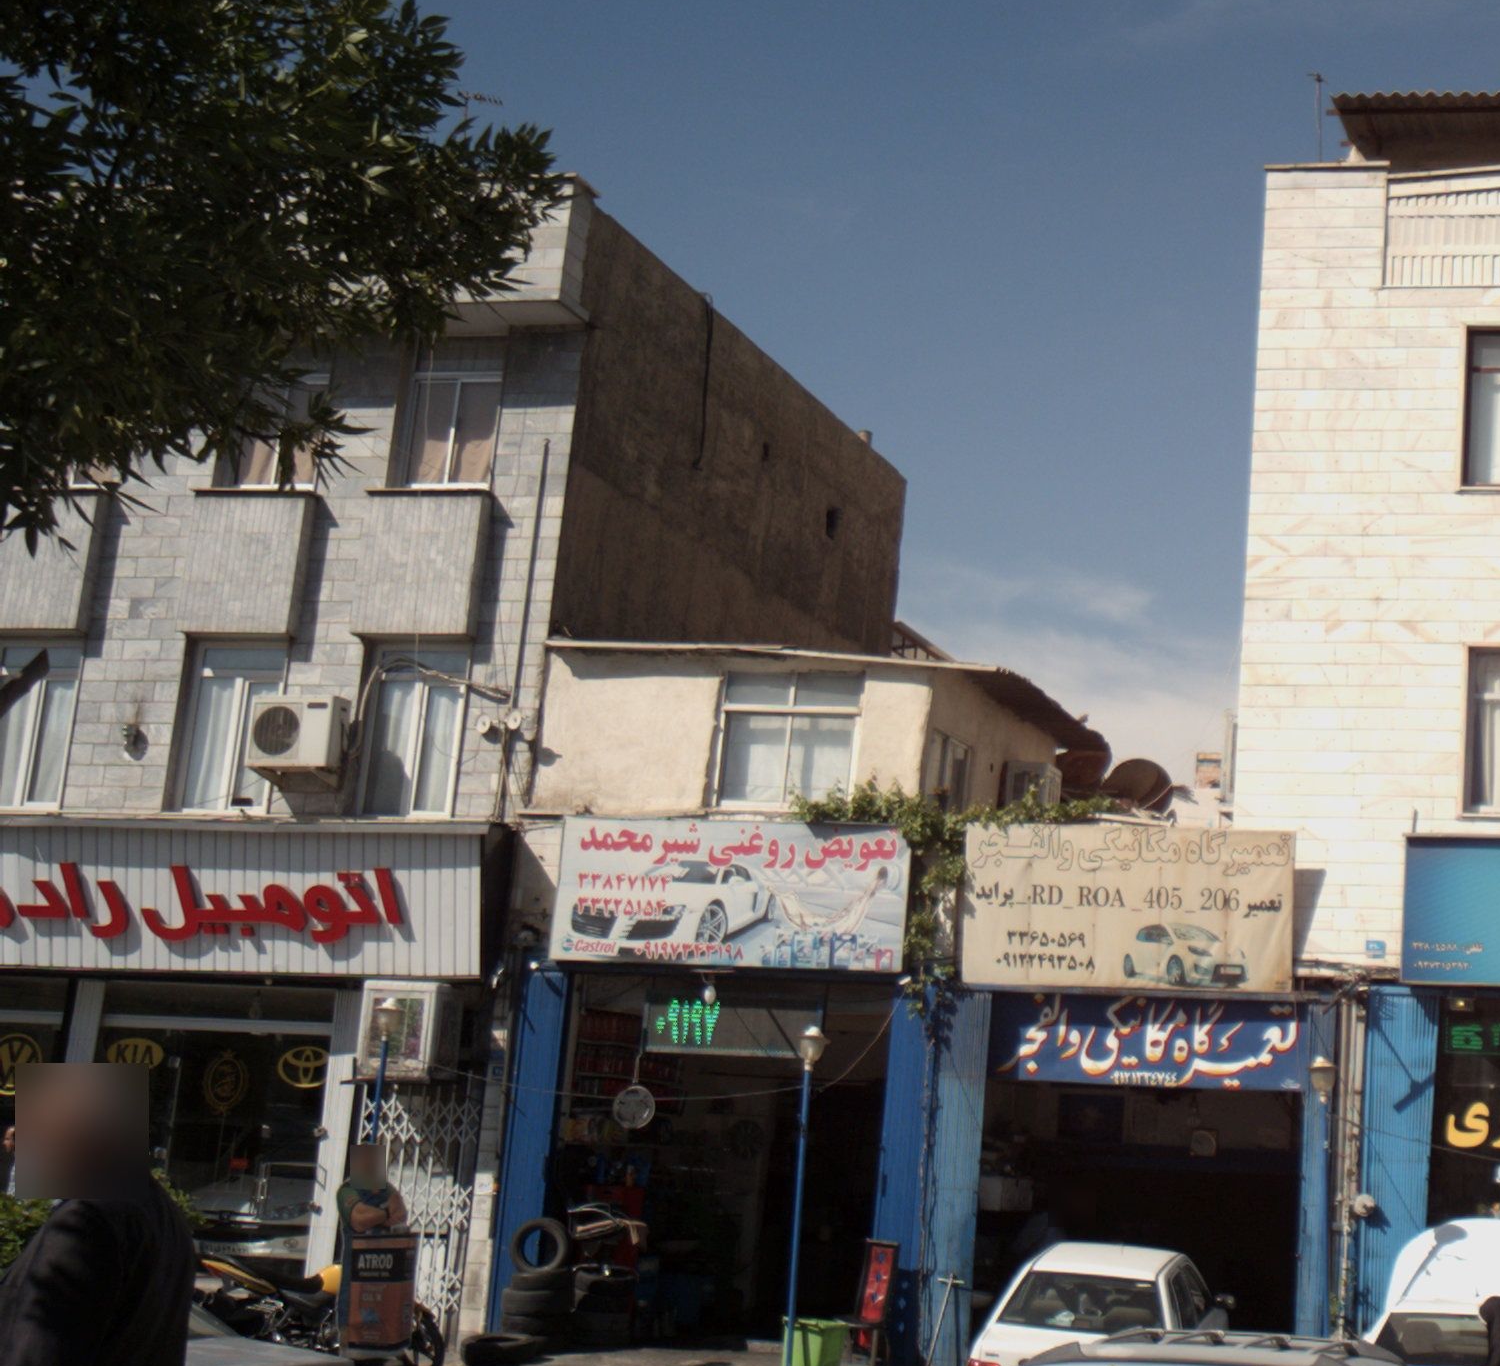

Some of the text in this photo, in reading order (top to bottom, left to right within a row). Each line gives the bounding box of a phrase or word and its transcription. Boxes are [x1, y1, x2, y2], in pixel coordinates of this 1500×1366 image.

[708, 823, 796, 870] روغنی
[971, 825, 1075, 872] والفجر
[1078, 827, 1182, 871] مکانیکی
[141, 865, 404, 945] اتومبیل
[1077, 885, 1127, 909] ROA
[1142, 886, 1183, 910] 405
[1199, 887, 1241, 912] 206
[1243, 893, 1283, 919] تعمیر
[574, 938, 617, 955] Castrol
[357, 1252, 394, 1271] ATROD
